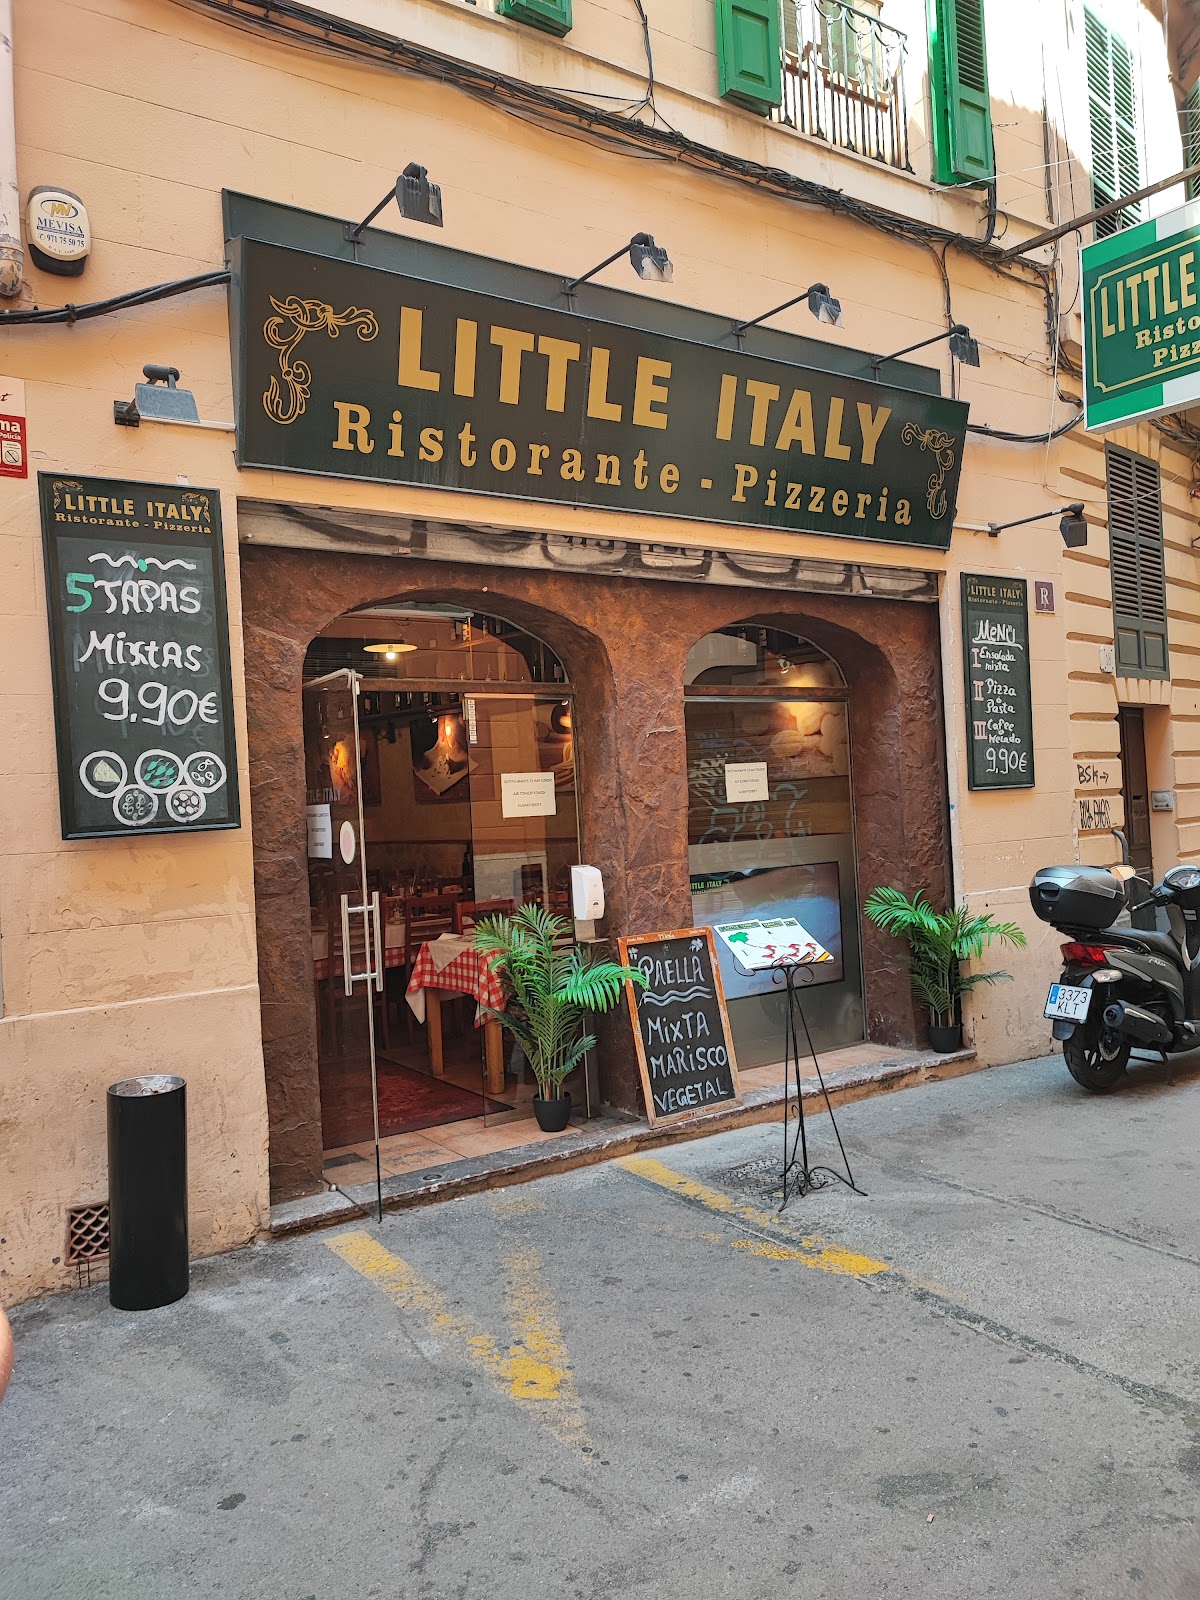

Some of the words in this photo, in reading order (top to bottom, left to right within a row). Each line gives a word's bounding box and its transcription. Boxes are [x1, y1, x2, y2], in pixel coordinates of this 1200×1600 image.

[37, 216, 83, 234] MEVISA
[46, 233, 58, 243] 971
[1100, 251, 1197, 338] LITTLE
[397, 305, 672, 430] LITTLE
[715, 373, 893, 465] ITALY
[332, 400, 680, 494] Ristorante
[731, 462, 912, 526] Pizzeria
[64, 493, 135, 516] LITTLE
[147, 501, 203, 522] ITALY
[54, 512, 140, 528] Ristorante
[153, 521, 212, 534] Pizzeria
[66, 572, 95, 613] 5
[93, 579, 201, 615] TAPAS
[971, 585, 996, 597] LITTLE
[1000, 587, 1021, 599] ITALY
[1040, 587, 1050, 605] R
[984, 677, 1017, 696] Pizza
[98, 677, 219, 726] 9.90€
[984, 698, 1016, 714] Pasta
[706, 880, 723, 888] ITALY
[637, 955, 706, 988] PAELLA
[1058, 988, 1088, 1004] 3373
[1056, 1000, 1080, 1015] KLT
[653, 1076, 730, 1113] VEGETAL
